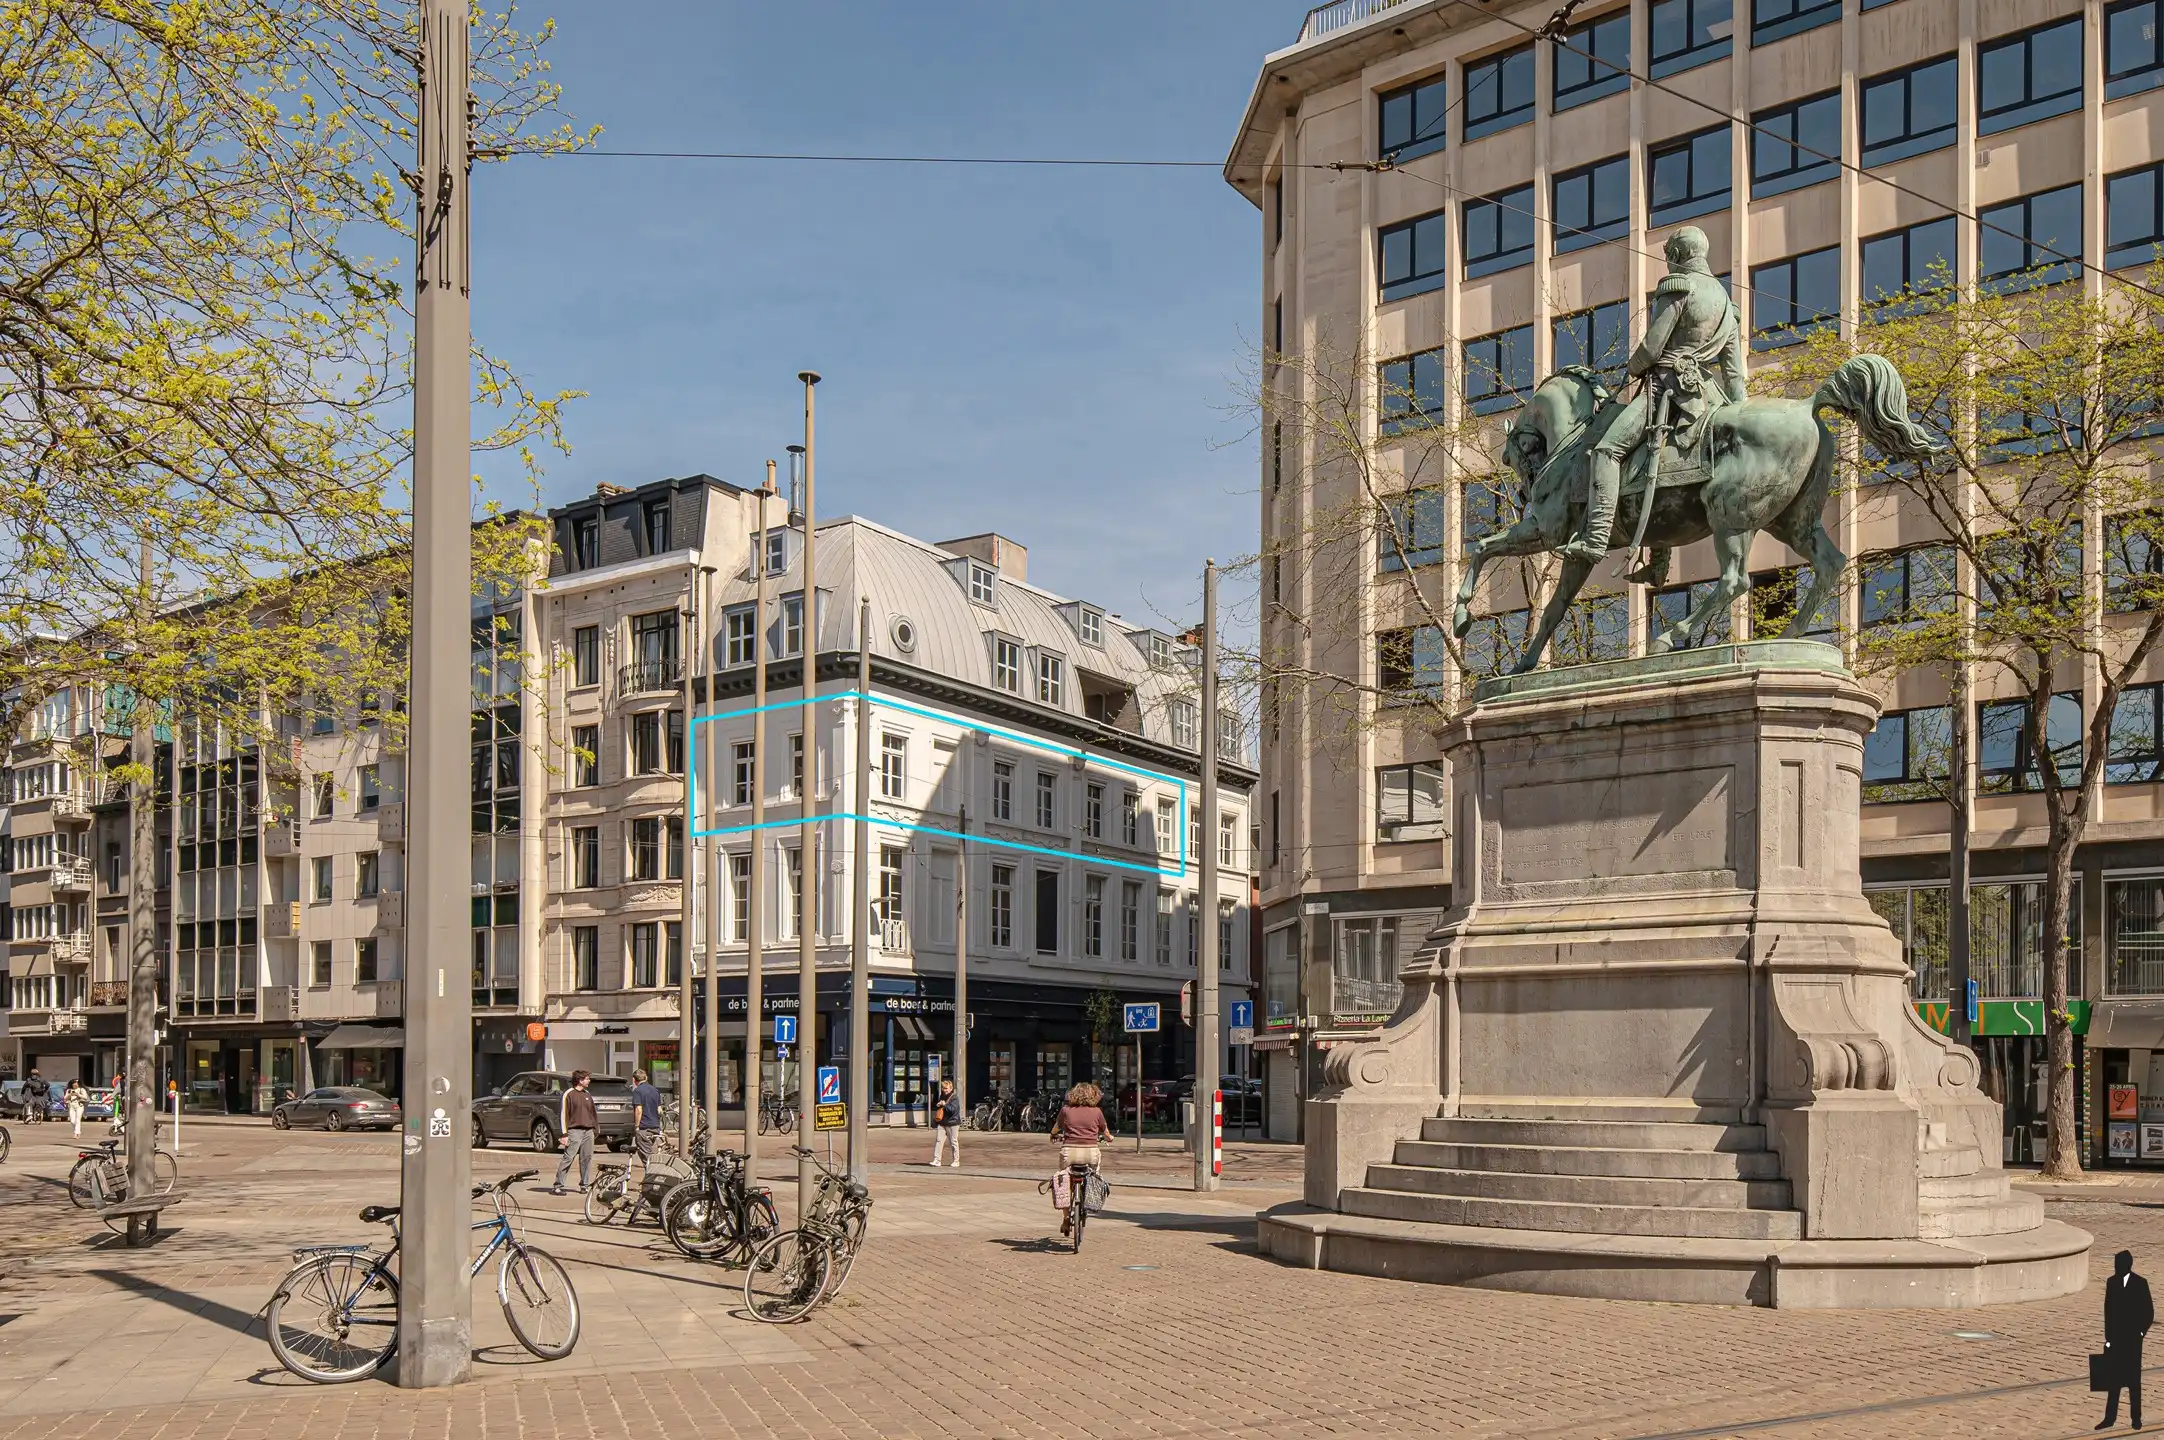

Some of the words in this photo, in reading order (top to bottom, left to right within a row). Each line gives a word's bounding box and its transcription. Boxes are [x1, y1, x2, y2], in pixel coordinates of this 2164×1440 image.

[728, 999, 739, 1010] de
[763, 999, 770, 1009] &
[772, 998, 800, 1011] partne
[886, 997, 898, 1008] de
[901, 998, 921, 1009] boer
[922, 1001, 928, 1010] &
[931, 1000, 956, 1012] partne
[1362, 1015, 1370, 1023] La
[471, 1243, 494, 1275] CHAUFF
